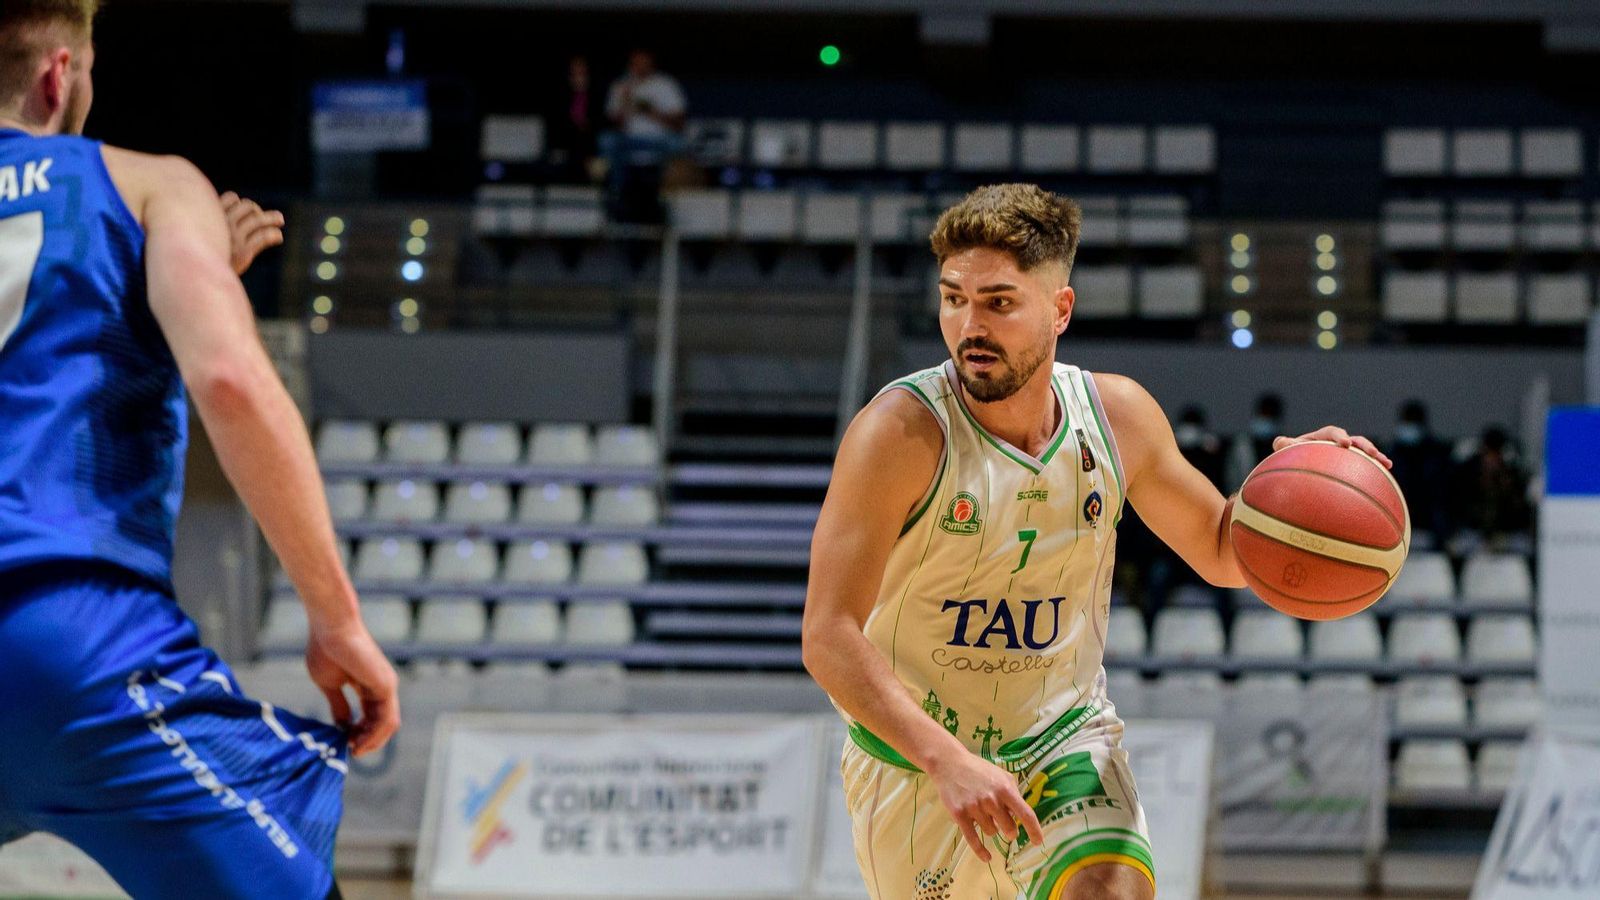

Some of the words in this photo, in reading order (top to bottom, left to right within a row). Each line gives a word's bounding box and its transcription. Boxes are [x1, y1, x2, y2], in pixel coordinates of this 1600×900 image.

[1016, 490, 1049, 501] SCORE
[943, 520, 978, 532] AMICS
[1011, 529, 1037, 574] 7
[941, 596, 1067, 650] TAU
[528, 780, 761, 818] COMUNITAT
[541, 818, 591, 854] DE
